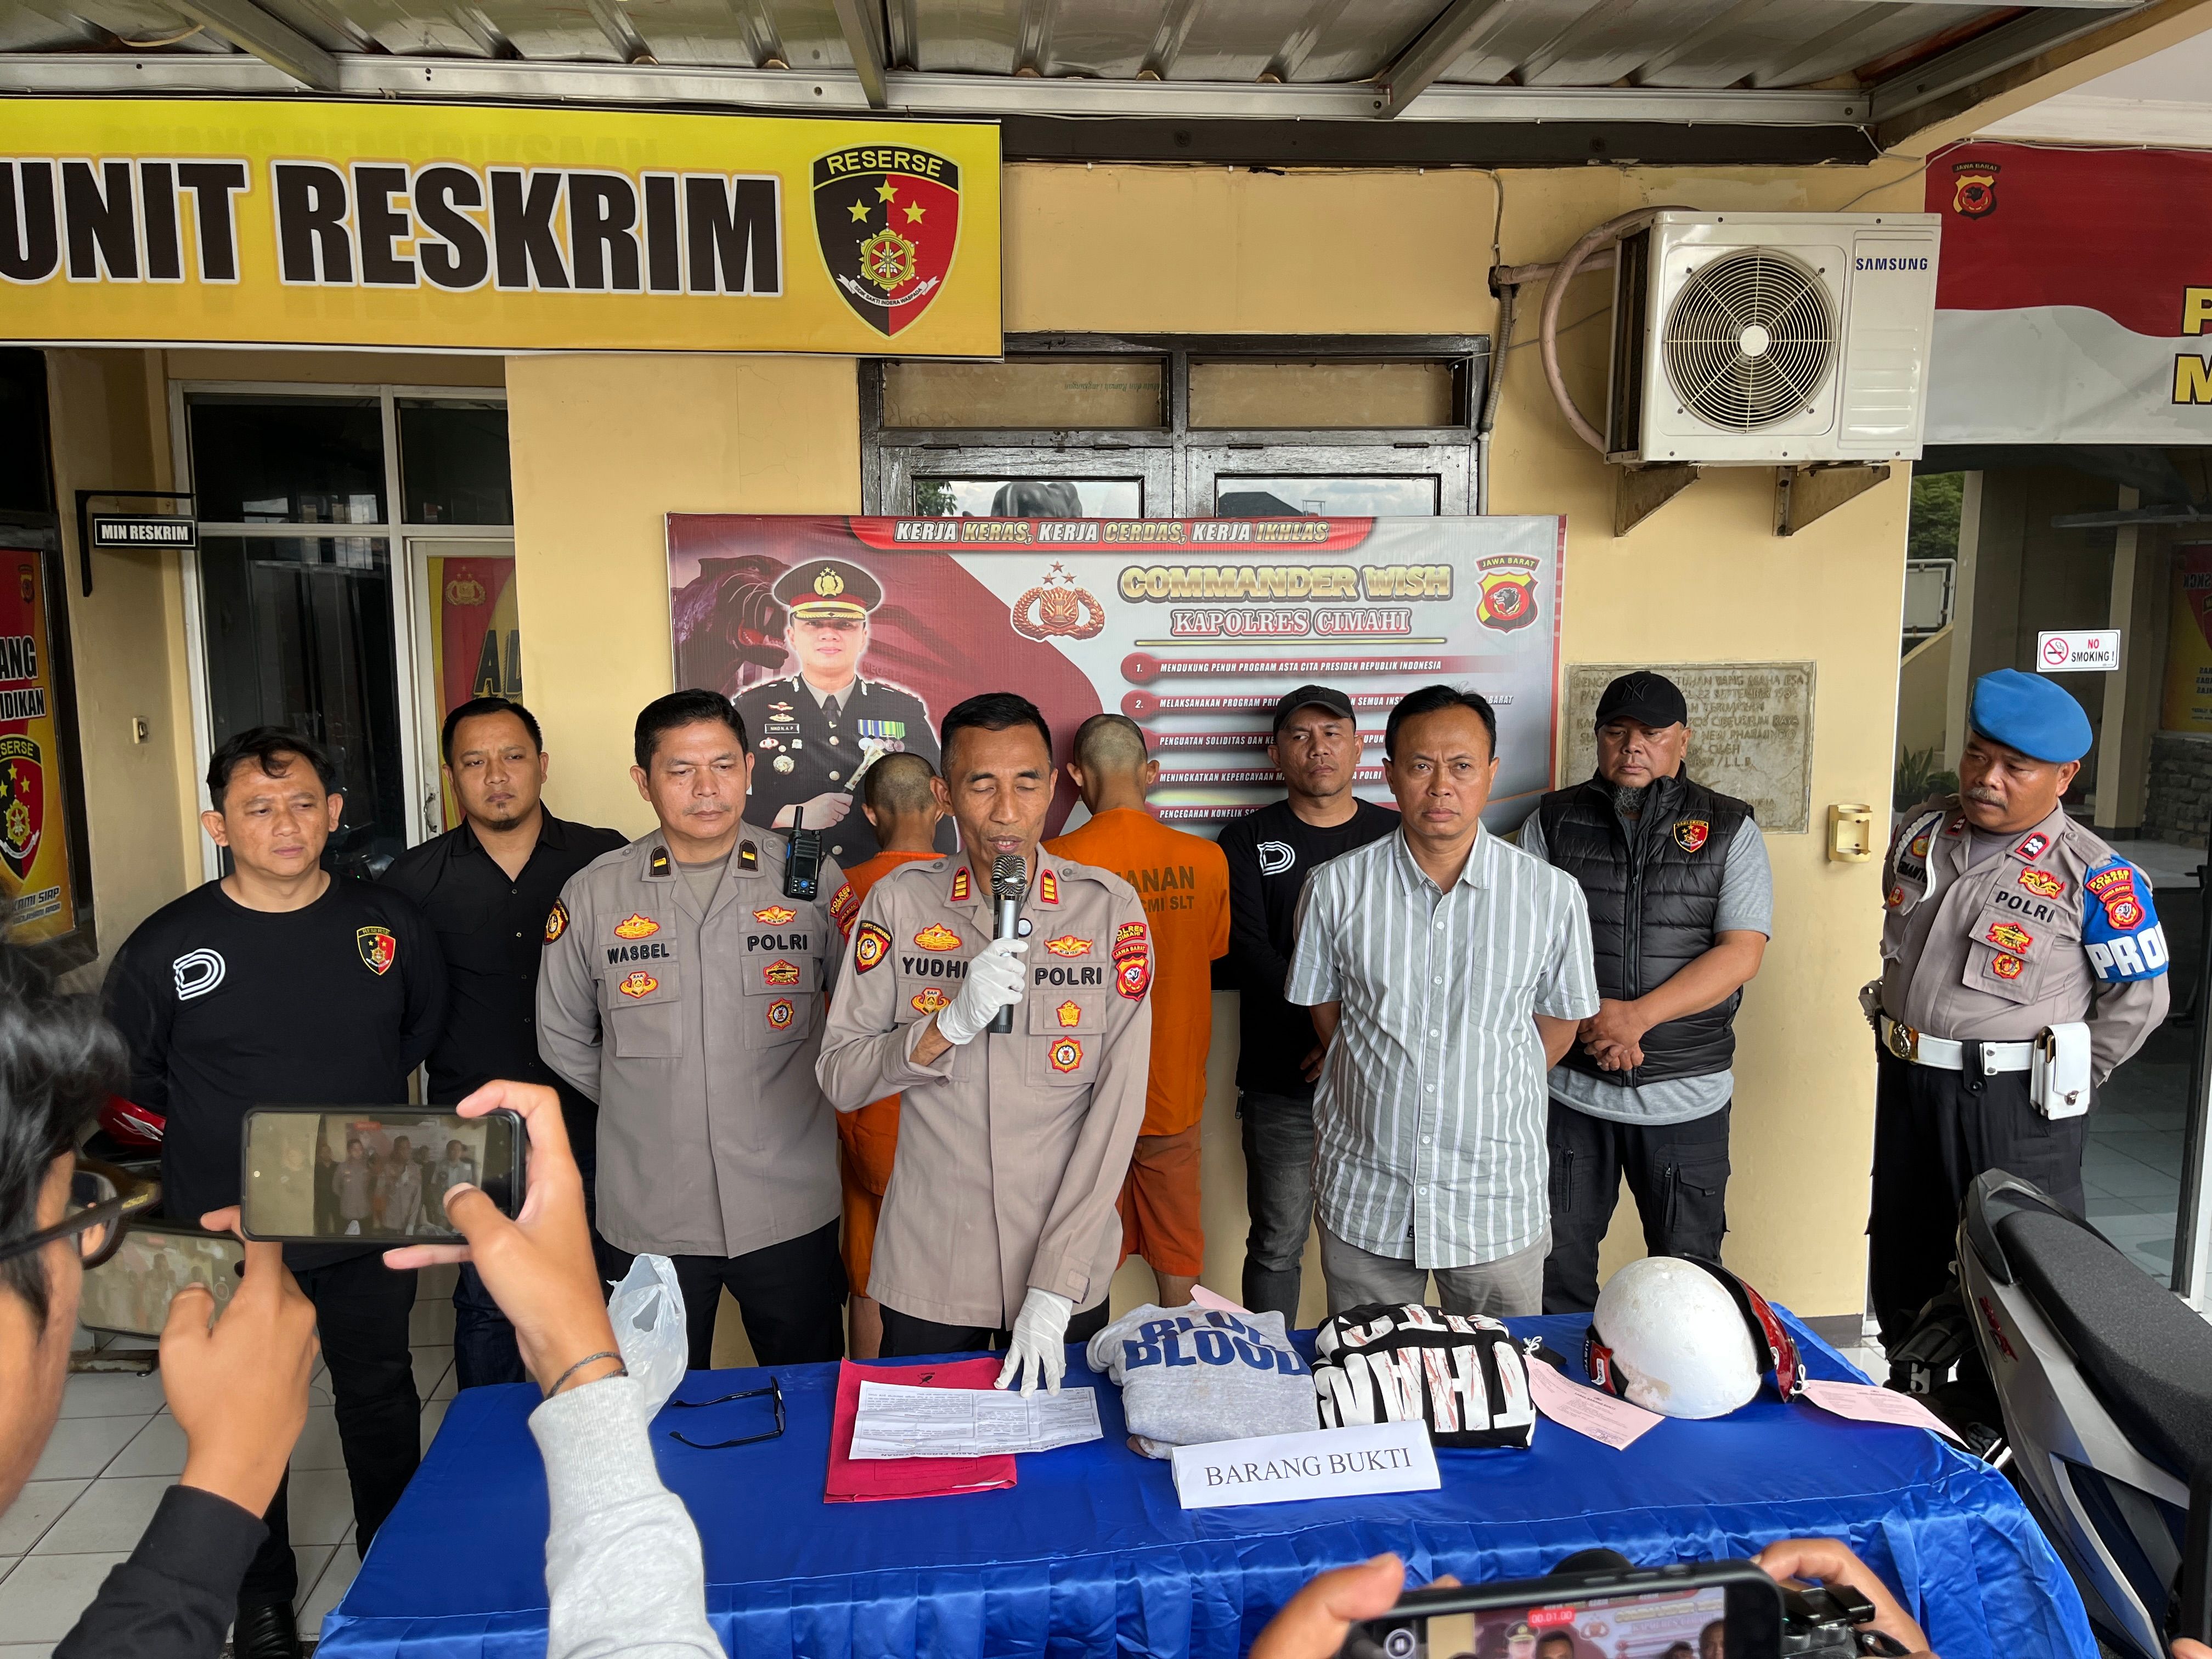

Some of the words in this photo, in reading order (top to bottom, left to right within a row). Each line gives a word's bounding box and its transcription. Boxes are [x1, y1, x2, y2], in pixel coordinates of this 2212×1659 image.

[827, 150, 943, 178] RESERSE
[0, 158, 249, 283] UNIT
[271, 160, 782, 297] RESKRIM
[1855, 258, 1928, 271] SAMSUNG
[854, 285, 866, 297] SIDIK
[866, 294, 880, 305] SAKTI
[900, 287, 922, 304] WASPADA
[101, 524, 128, 540] MIN
[129, 525, 189, 542] RESKRIM
[895, 521, 958, 542] KERJA
[962, 521, 1033, 544] KERAS,
[1037, 522, 1099, 543] KERJA
[1103, 522, 1187, 544] CERDAS,
[1191, 522, 1252, 543] KERJA
[1255, 522, 1329, 543] IKHLAS
[1482, 557, 1505, 567] JAWA
[1508, 557, 1535, 567] BARAT
[1120, 566, 1358, 600] COMMANDER
[1364, 565, 1453, 600] WISH
[1172, 609, 1311, 636] KAPOLRES
[1314, 609, 1410, 635] CIMAHI
[2087, 638, 2100, 649] NO
[2071, 651, 2109, 662] SMOKING
[1136, 664, 1143, 672] 1.
[1160, 663, 1209, 672] MENDUKUNG
[1211, 663, 1235, 672] PENUH
[1239, 663, 1276, 672] PROGRAM
[1278, 662, 1298, 672] ASTA
[1300, 662, 1318, 672] CITA
[1321, 662, 1358, 671] PRESIDEN
[1360, 661, 1397, 670] REPUBLIK
[1400, 661, 1441, 670] INDONESIA
[1573, 677, 1611, 687] DENGA
[1713, 688, 1771, 698] SEPTEMBER
[1135, 700, 1143, 708] 2.
[1160, 699, 1220, 708] MELAKSANAKAN
[1222, 698, 1260, 707] PROGRAM
[1357, 697, 1384, 706] SEMUA
[1488, 696, 1514, 705] BARAT
[1772, 714, 1799, 726] RAYA
[1159, 737, 1203, 745] PENGUATAN
[1205, 736, 1245, 745] SOLIDITAS
[1248, 736, 1263, 744] DAN
[1159, 773, 1219, 782] MENINGKATKAN
[1221, 772, 1274, 781] KEPERCAYAAN
[1359, 771, 1381, 780] POLRI
[1159, 809, 1209, 819] PENCEGAHAN
[1211, 809, 1242, 817] KONFLIK
[2090, 870, 2130, 889] POLRES
[38, 887, 60, 904] SIAP
[830, 885, 850, 914] POLRES
[1170, 895, 1195, 911] SLT
[1995, 891, 2056, 924] POLRI
[1117, 925, 1144, 936] OLRES
[607, 943, 670, 964] WASBEL
[747, 934, 808, 952] POLRI
[1115, 947, 1130, 957] JAWA
[902, 956, 968, 979] YUDHI
[1035, 966, 1102, 986] POLRI
[1122, 1330, 1313, 1376] BLOOD
[1206, 1455, 1321, 1487] BARANG
[1330, 1447, 1413, 1475] BUKTI
